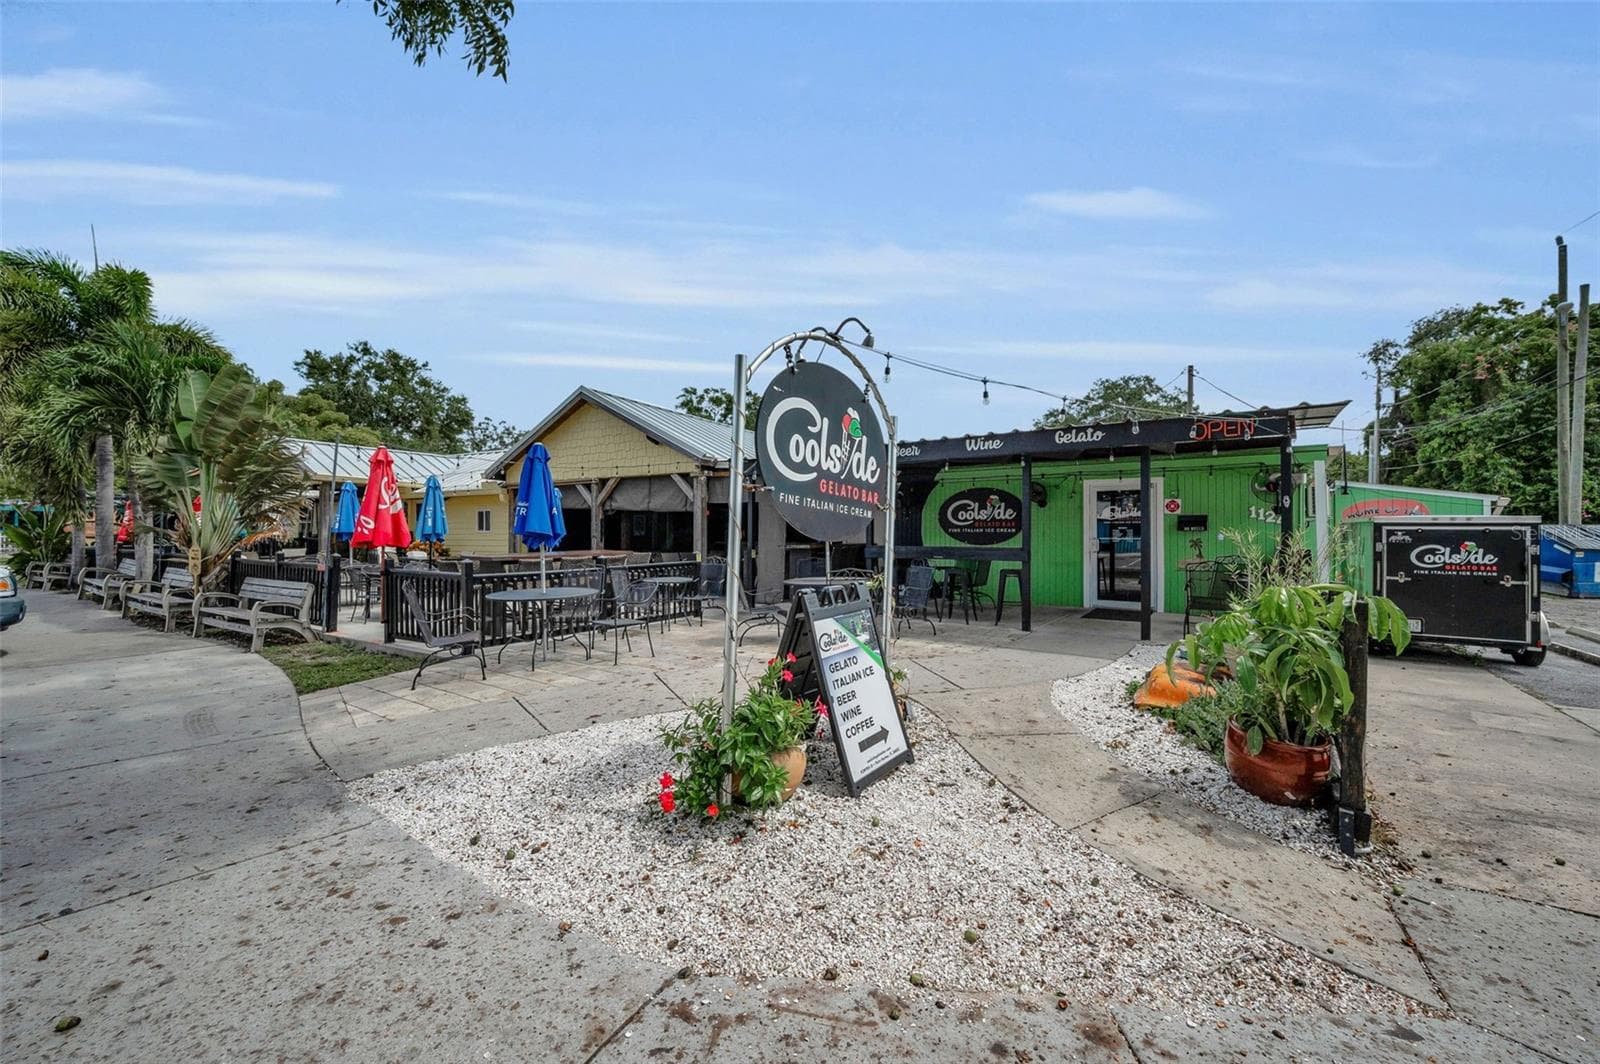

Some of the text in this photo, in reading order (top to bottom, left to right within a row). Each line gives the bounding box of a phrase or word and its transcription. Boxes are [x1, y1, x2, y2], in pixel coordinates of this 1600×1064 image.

[1054, 427, 1106, 444] Gelato
[1194, 417, 1255, 440] OPEN
[965, 437, 1004, 452] Wine
[819, 478, 880, 506] GELATO BAR
[779, 491, 873, 519] FINE ITALIAN ICE CREAM
[828, 655, 858, 674] GELATO
[831, 665, 875, 691] ITALIAN ICE
[836, 690, 857, 707] BEER
[840, 705, 862, 723] WINE
[845, 716, 875, 739] COFFEE
